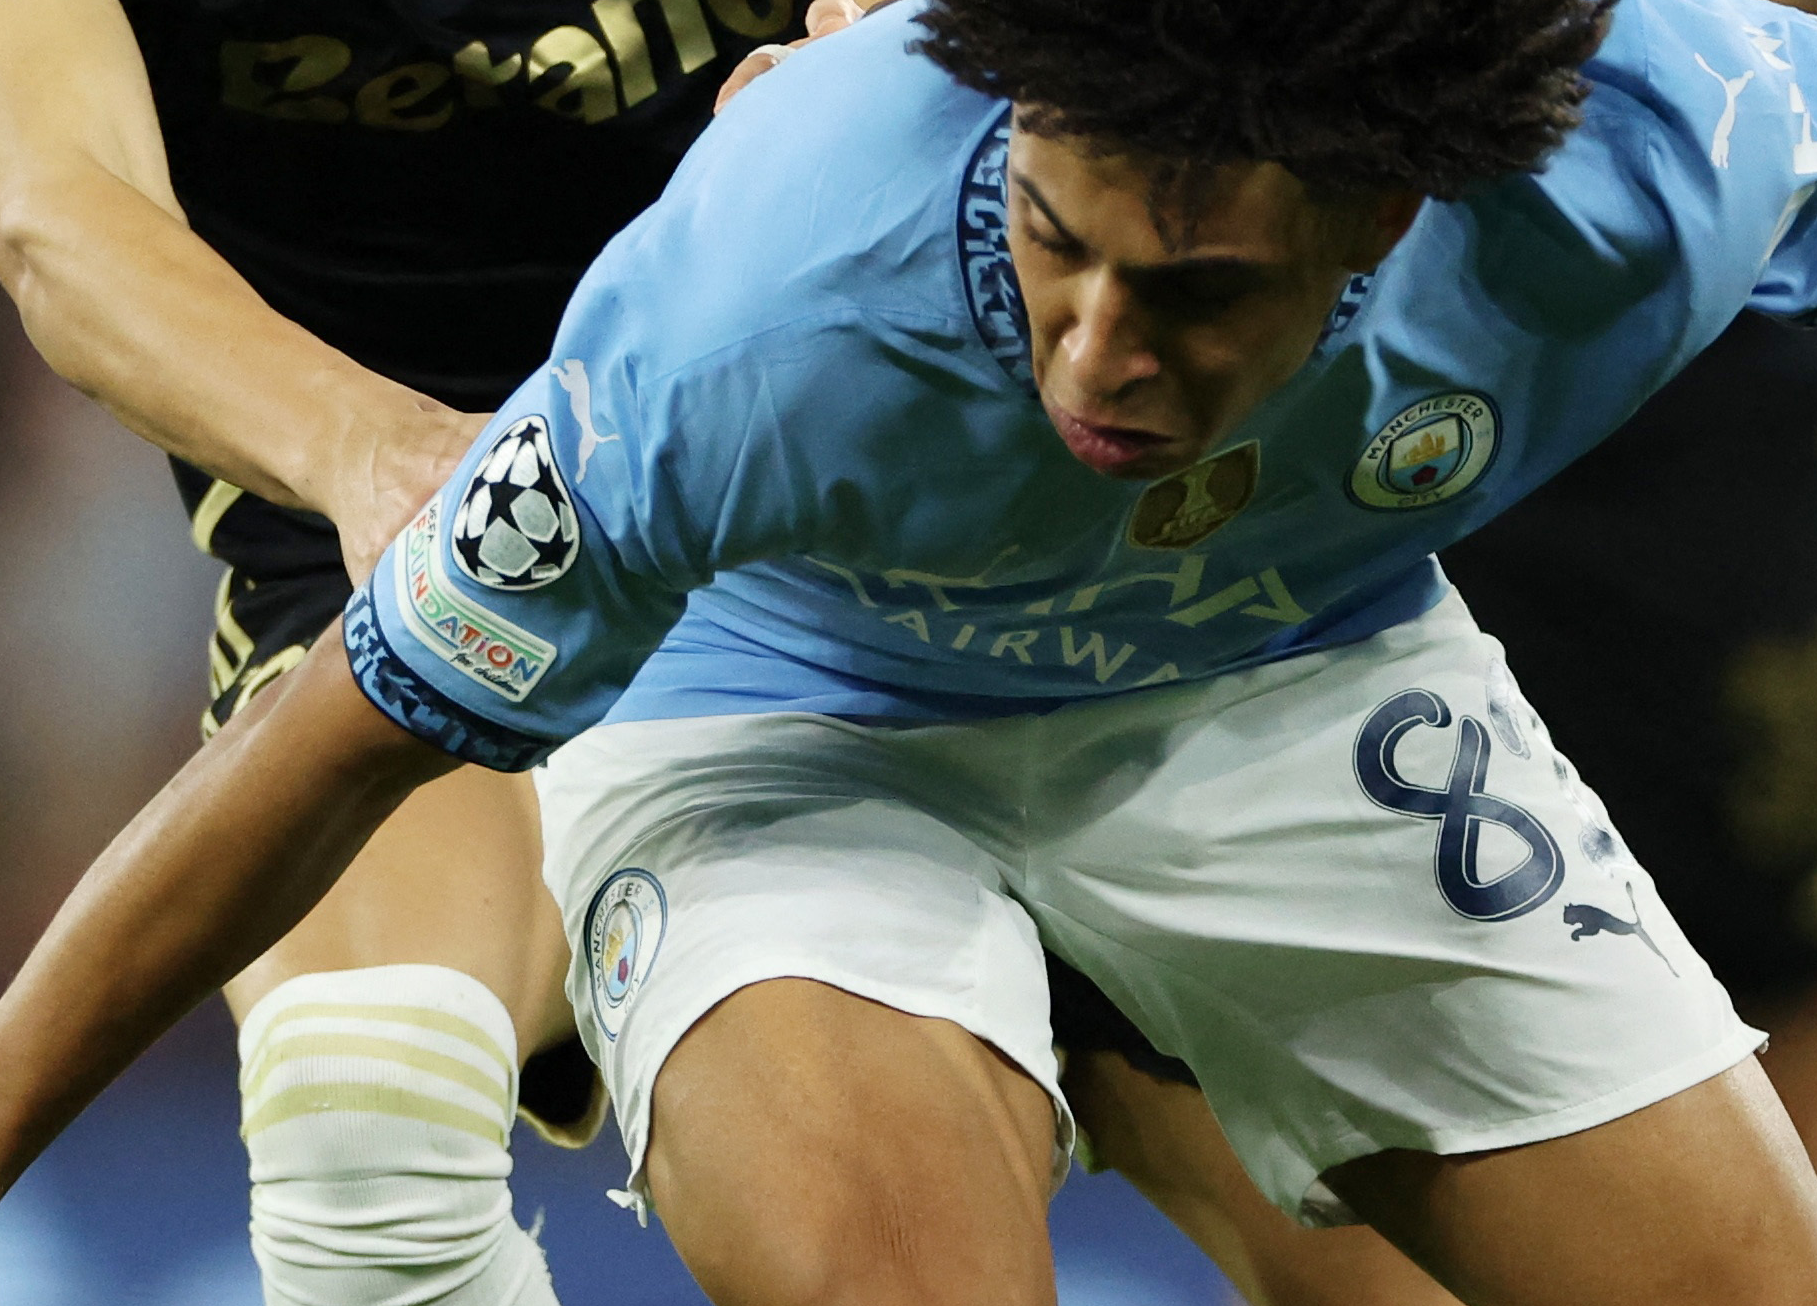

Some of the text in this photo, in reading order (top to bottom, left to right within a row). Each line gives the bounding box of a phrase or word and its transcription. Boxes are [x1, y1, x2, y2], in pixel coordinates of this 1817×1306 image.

[1367, 398, 1484, 460] MANCHESTER
[428, 502, 439, 543] UEFA
[449, 651, 474, 668] for
